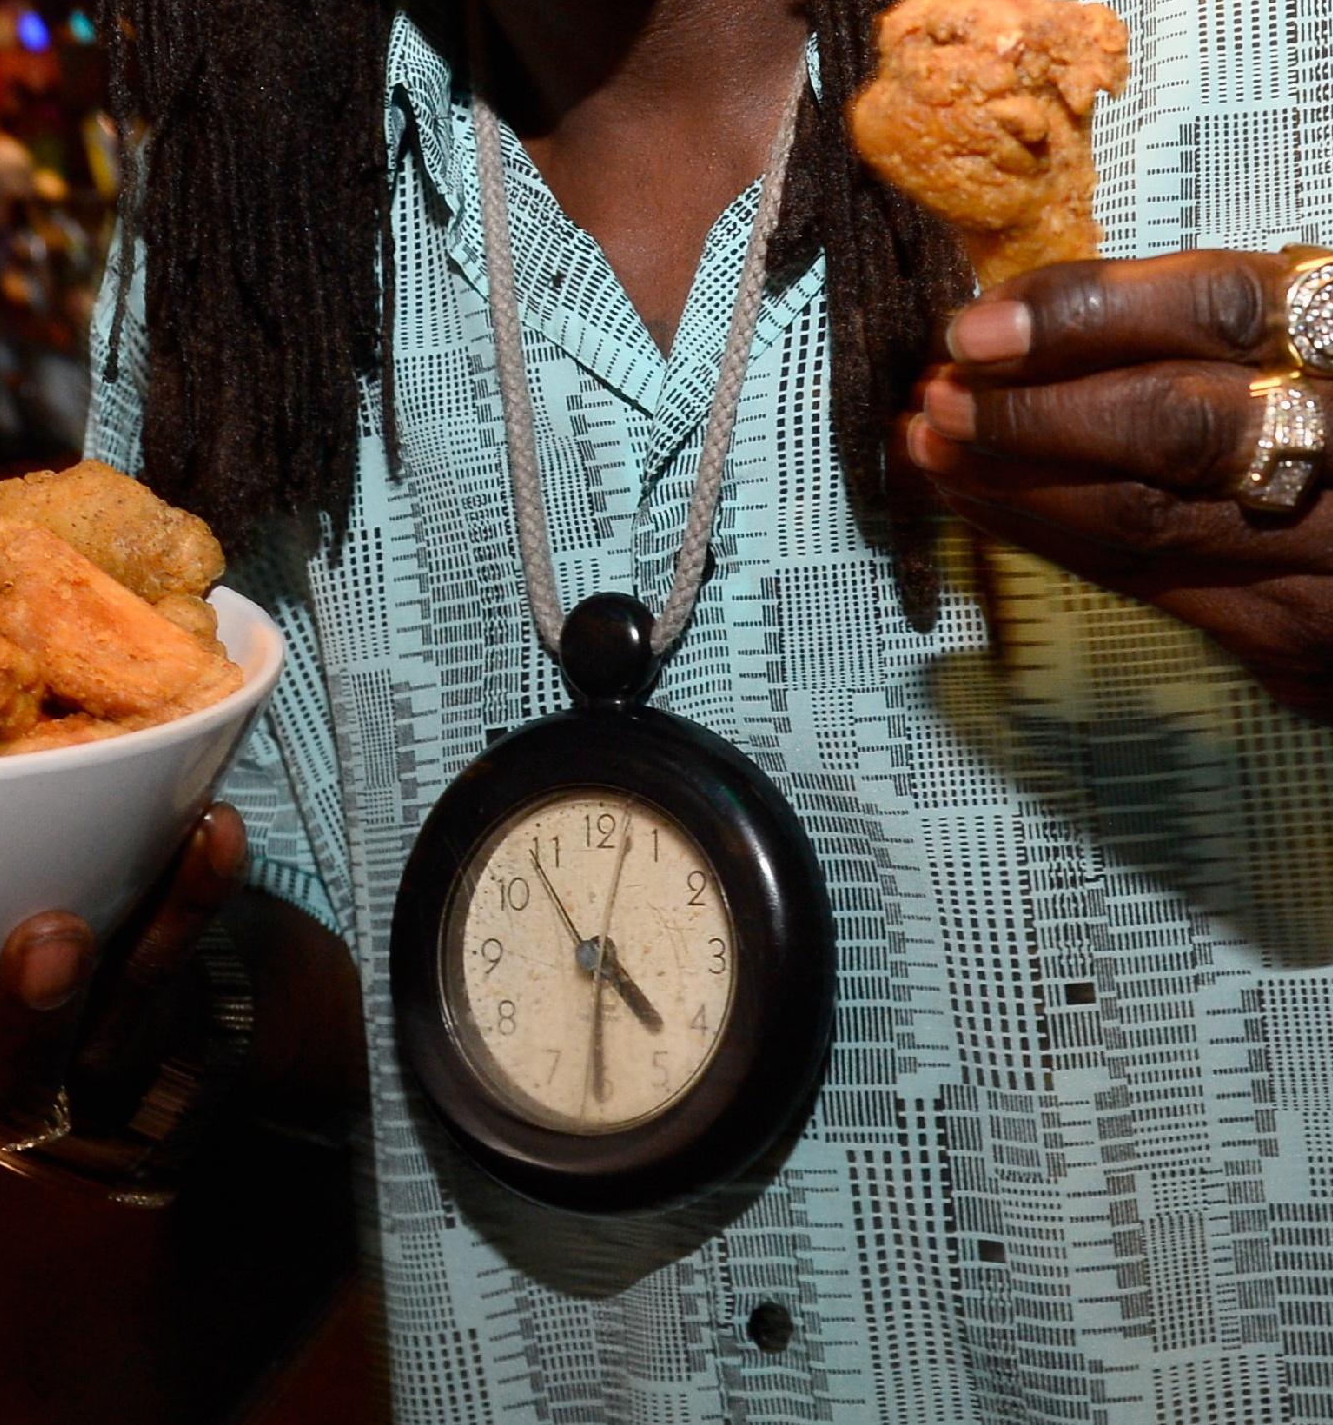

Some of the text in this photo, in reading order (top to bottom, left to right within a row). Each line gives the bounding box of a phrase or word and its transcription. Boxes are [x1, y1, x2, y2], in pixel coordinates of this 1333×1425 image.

[584, 813, 616, 849] 12
[652, 828, 660, 863] 1
[497, 877, 530, 911] 10
[686, 870, 707, 906] 2
[480, 937, 503, 974] 9
[707, 937, 727, 975] 3
[497, 1000, 516, 1037] 8
[688, 1003, 708, 1037] 4
[544, 1048, 562, 1086] 7
[651, 1049, 668, 1088] 5
